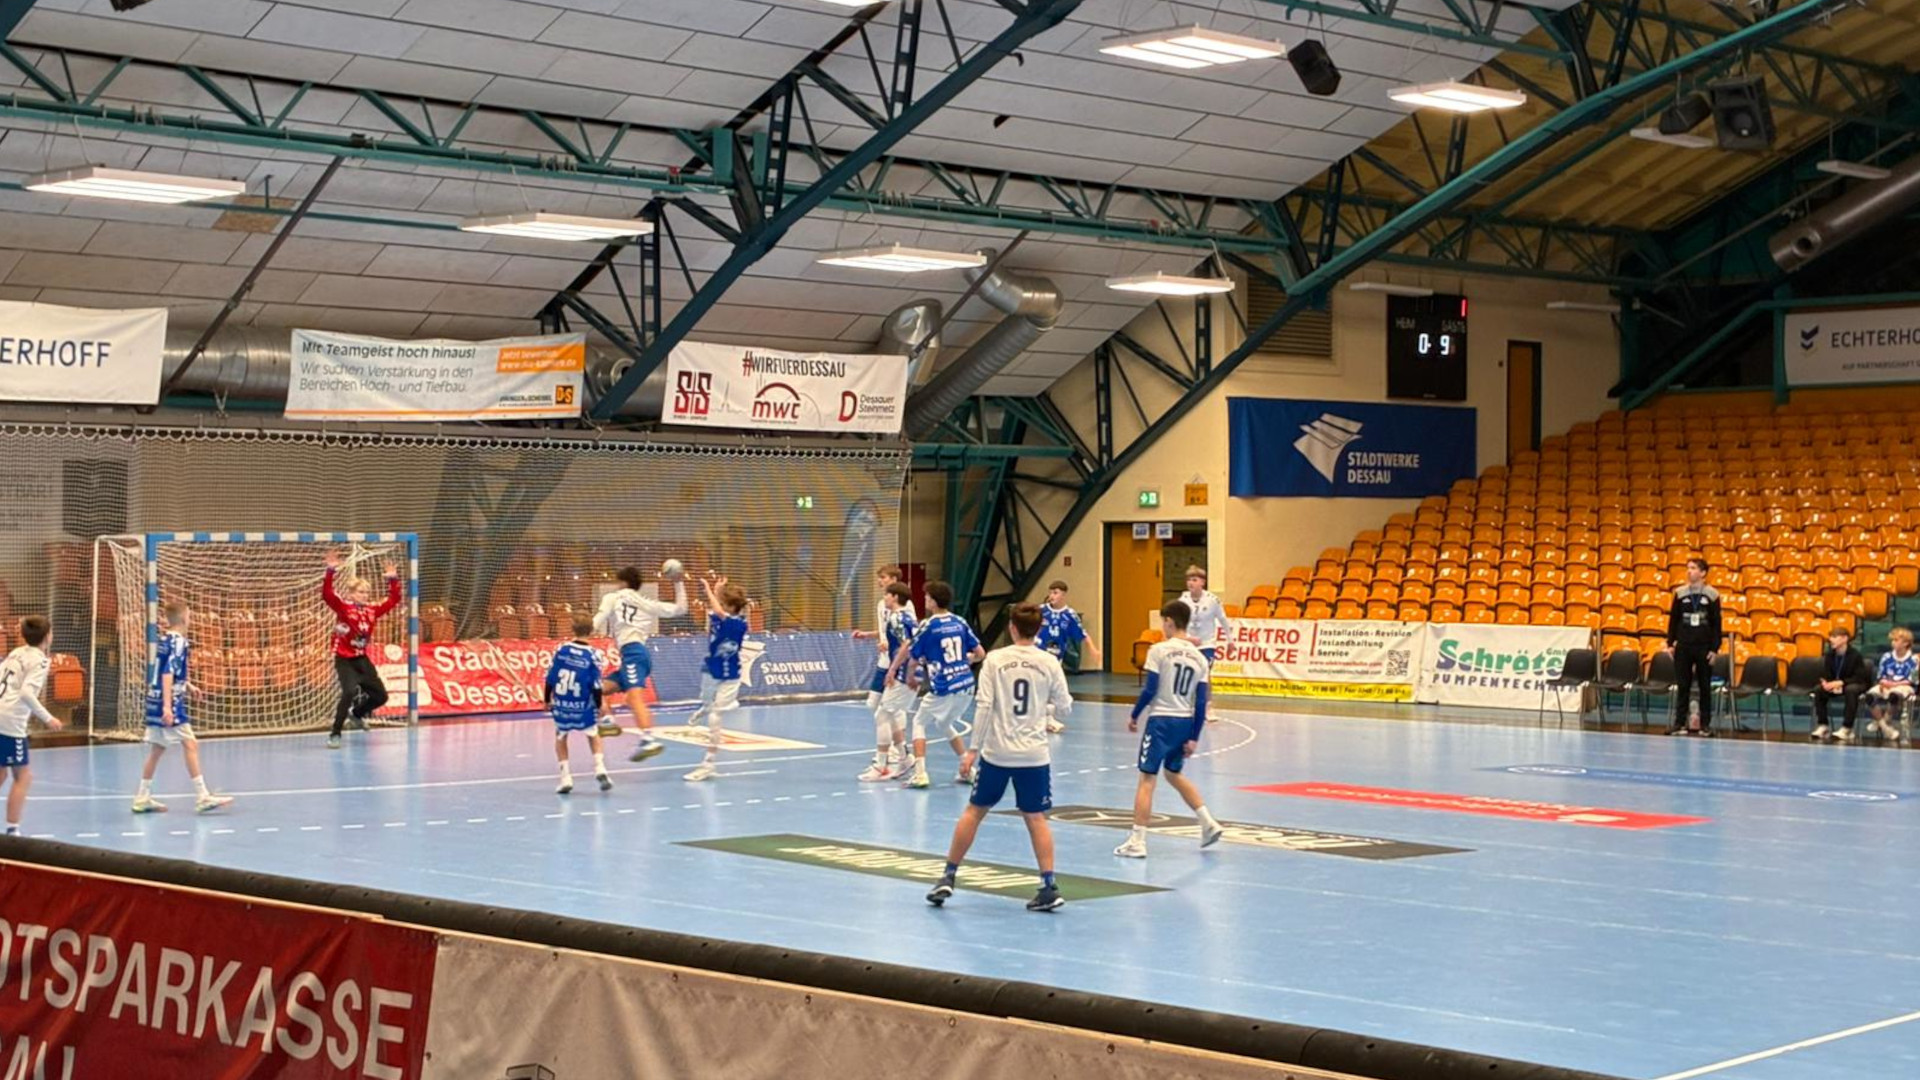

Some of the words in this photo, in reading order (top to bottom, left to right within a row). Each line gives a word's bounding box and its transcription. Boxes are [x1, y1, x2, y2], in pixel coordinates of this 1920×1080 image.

[0, 338, 111, 367] ERHOFF
[327, 344, 393, 359] Teamgeist
[397, 346, 428, 358] hoch
[432, 347, 476, 359] hinaus!
[301, 362, 320, 374] Wir
[323, 363, 363, 376] suchen
[368, 365, 437, 379] Verstärkung
[440, 366, 449, 377] in
[452, 366, 473, 378] den
[742, 351, 845, 378] #WIRFUERDESSAU
[300, 378, 358, 391] Bereichen
[399, 382, 422, 393] und
[859, 404, 895, 413] Steinmetz
[860, 394, 895, 405] Dessauer
[752, 401, 800, 419] mwc
[1348, 452, 1420, 468] STADTWERKE
[1348, 469, 1391, 484] DESSAU
[622, 602, 637, 623] 17
[1216, 626, 1300, 645] EEKTRO
[941, 636, 963, 663] 31
[1436, 639, 1563, 677] Schröte
[555, 668, 580, 697] 34
[1173, 662, 1195, 696] 10
[443, 681, 544, 706] Dessau
[1013, 678, 1029, 716] 9
